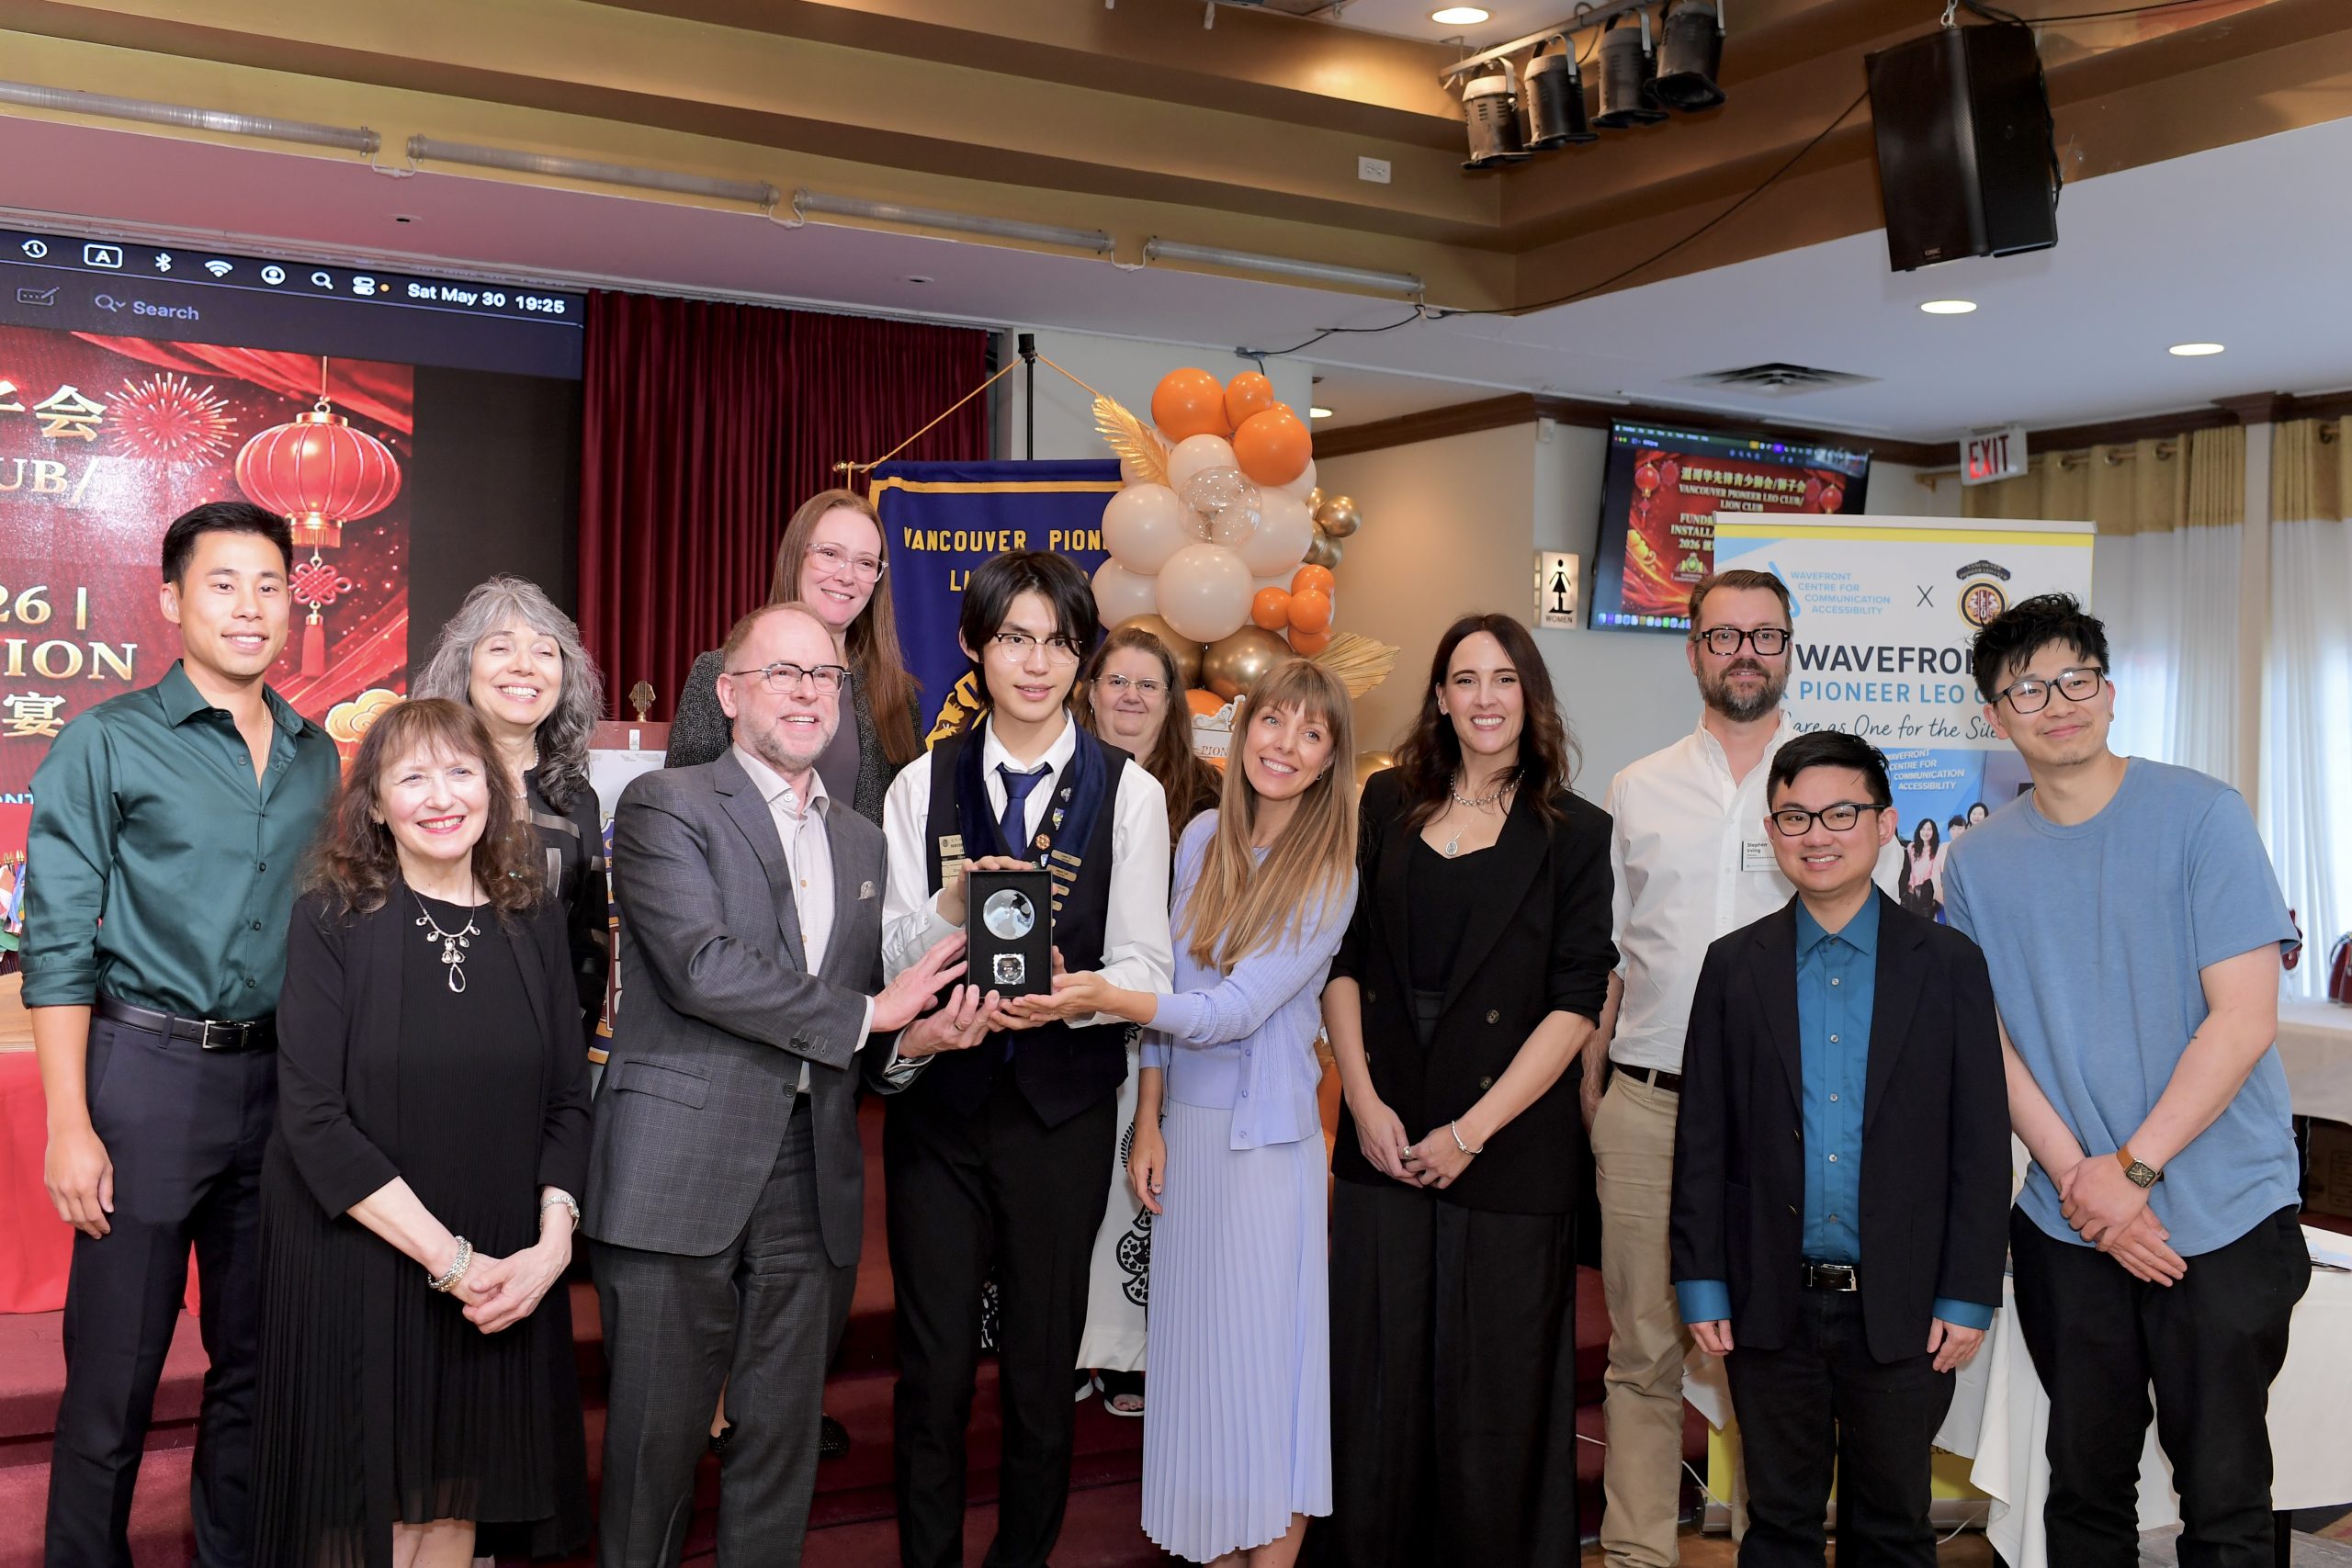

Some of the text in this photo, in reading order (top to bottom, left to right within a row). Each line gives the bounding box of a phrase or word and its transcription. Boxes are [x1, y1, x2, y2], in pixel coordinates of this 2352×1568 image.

[95, 250, 111, 264] A
[407, 282, 566, 314] Sat May 30 19:25
[133, 300, 199, 321] Search
[1969, 434, 2009, 480] EXIT
[1679, 484, 1727, 497] VANCOUVER
[1728, 489, 1762, 502] PIONEER
[1762, 492, 1780, 503] LEO
[1720, 500, 1764, 512] LION CLUB
[904, 526, 1108, 552] VANCOUVER PION
[1679, 537, 1701, 549] 2026
[1791, 570, 1852, 581] WAVEFRONT
[1798, 582, 1860, 592] CENTRE FOR
[1804, 594, 1891, 604] COMMUNICATION
[1812, 604, 1883, 615] ACCESSIBILITY
[1545, 615, 1573, 623] WOMEN
[1800, 681, 1910, 704] PIONEER
[1919, 684, 1965, 705] LEO
[2, 691, 66, 738] 宴
[1854, 714, 1893, 737] One
[1898, 714, 1925, 740] for
[1928, 717, 1961, 739] the
[1889, 759, 1938, 772] CENTRE FOR
[1894, 769, 1965, 781] COMMUNICATION
[1898, 781, 1957, 791] ACCESSIBILITY
